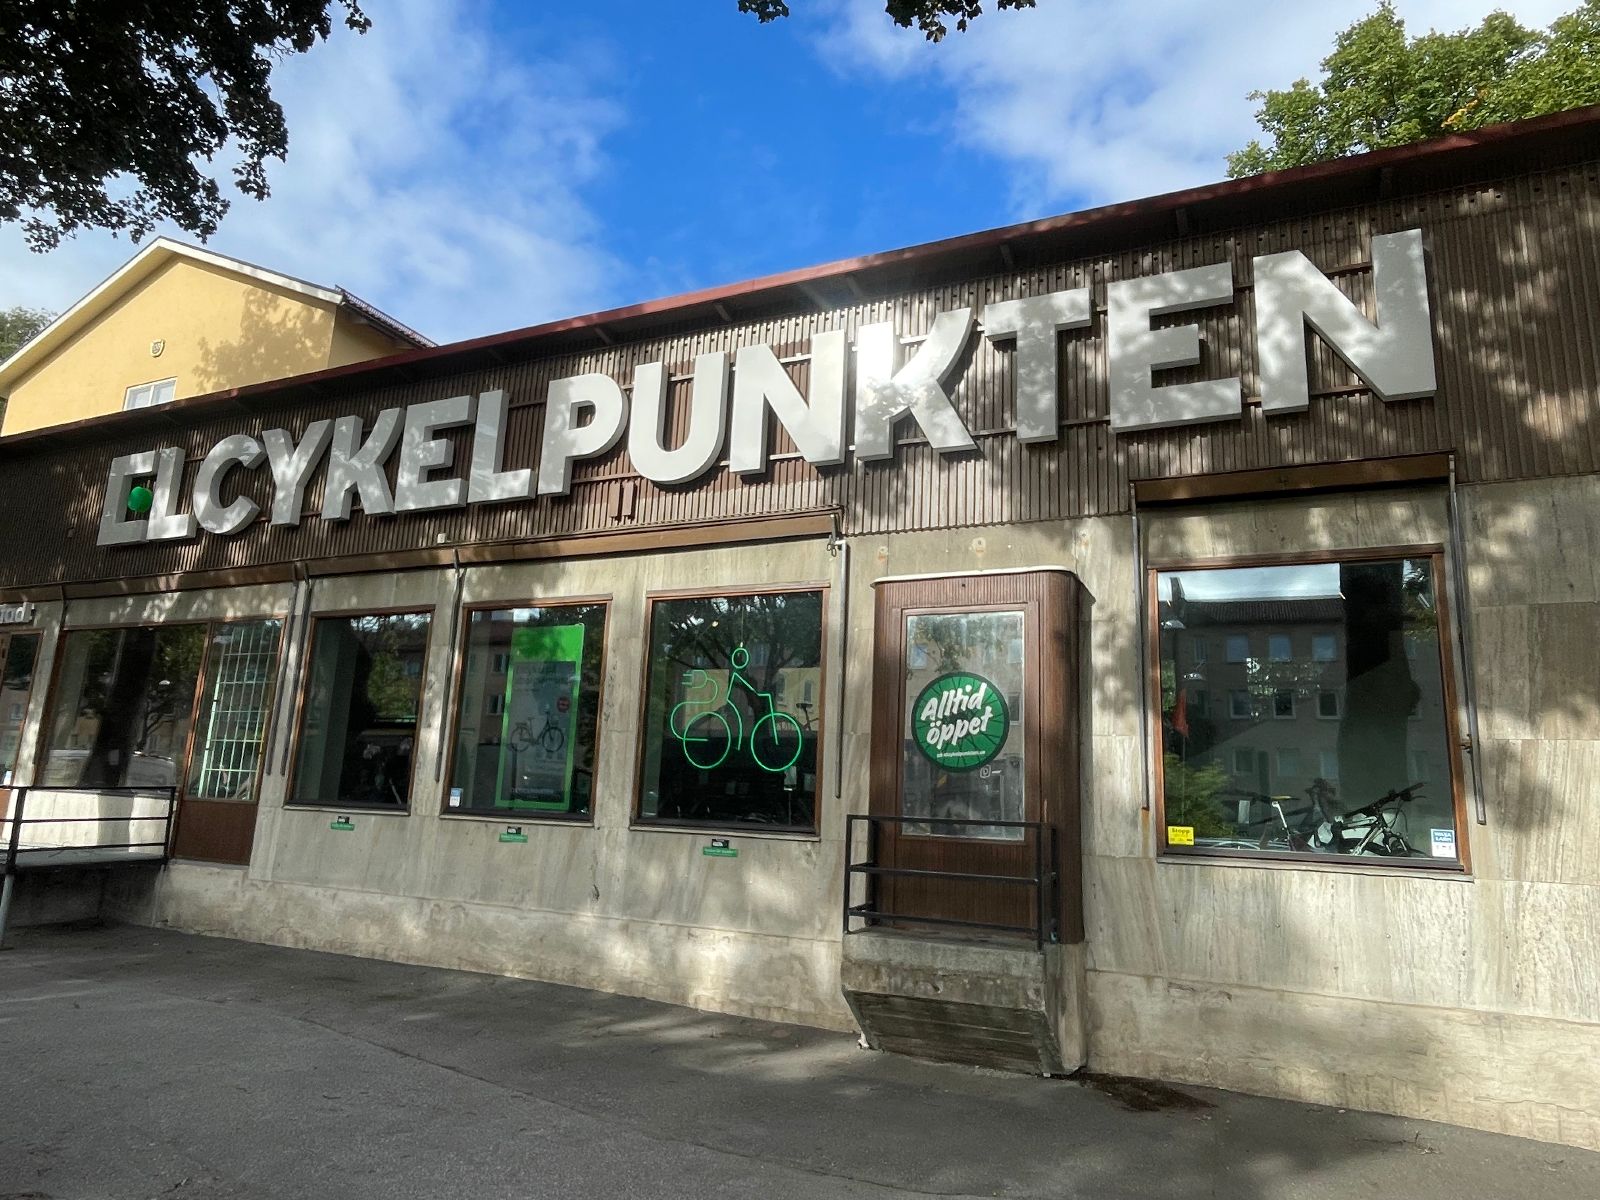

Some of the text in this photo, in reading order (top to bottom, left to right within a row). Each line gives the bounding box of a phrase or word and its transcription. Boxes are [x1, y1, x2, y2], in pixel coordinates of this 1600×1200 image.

[97, 229, 1438, 546] ELCYKELPUNKTEN
[921, 682, 987, 721] Alltid
[926, 705, 993, 750] öppet
